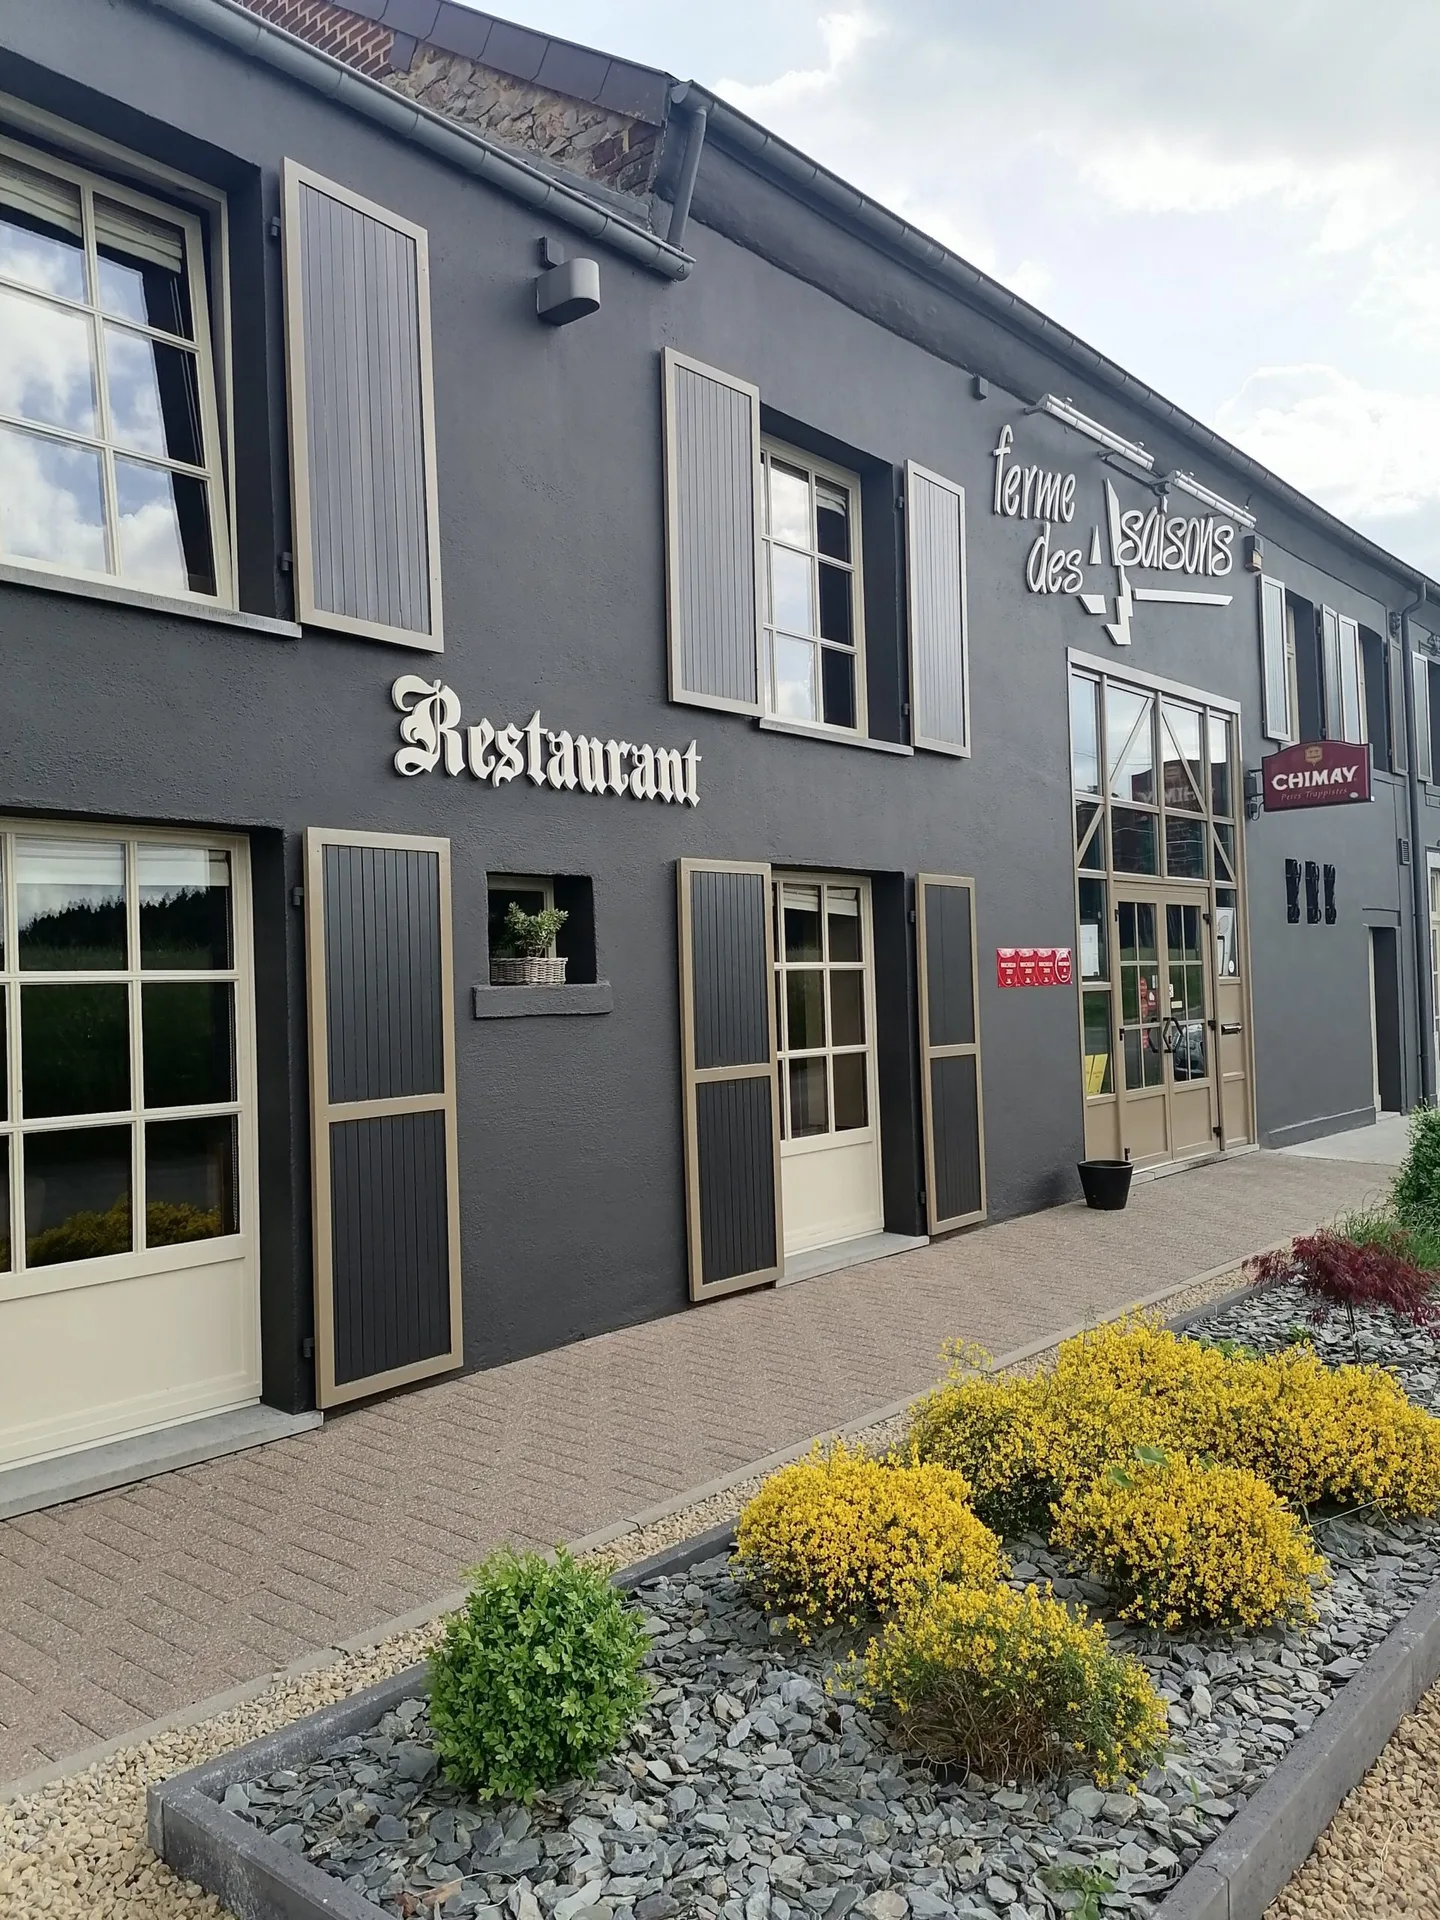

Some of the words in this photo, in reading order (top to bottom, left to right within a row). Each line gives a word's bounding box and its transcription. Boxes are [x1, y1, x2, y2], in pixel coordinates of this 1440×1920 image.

[993, 424, 1076, 523] ferme
[1027, 521, 1084, 594] des
[1117, 497, 1235, 576] saisons
[391, 674, 702, 808] Restaurant
[1271, 765, 1359, 791] CHIMAY
